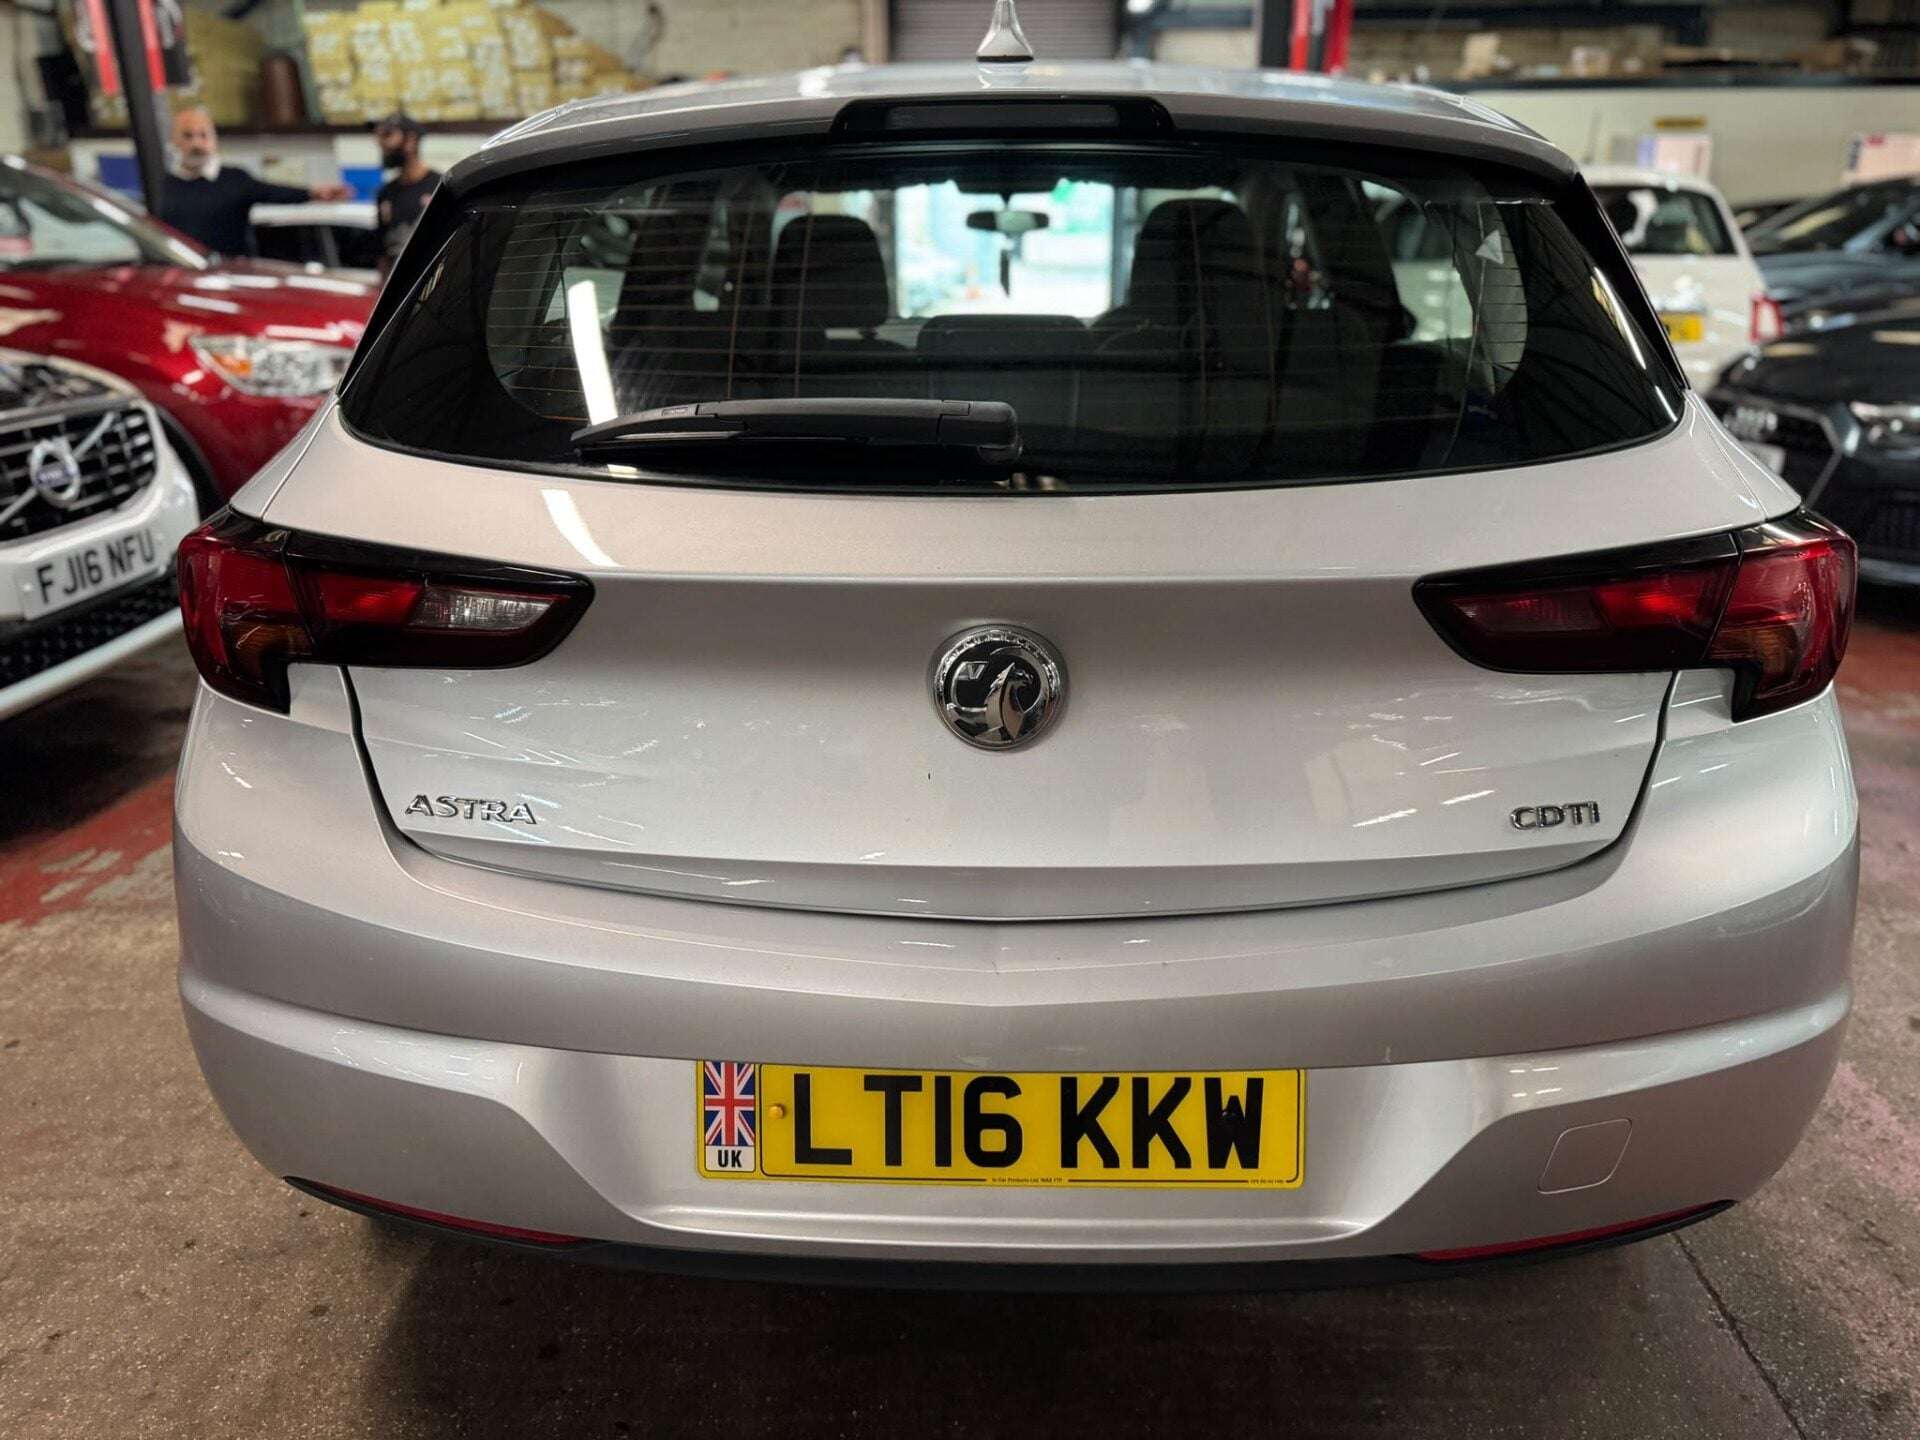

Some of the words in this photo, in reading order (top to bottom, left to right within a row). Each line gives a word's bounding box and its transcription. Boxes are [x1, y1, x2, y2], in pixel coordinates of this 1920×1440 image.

[37, 549, 103, 604] FJ16
[106, 528, 156, 578] NFU
[405, 794, 537, 824] ASTRA
[1510, 801, 1600, 830] CDTI
[793, 1072, 1024, 1168] LT16
[1059, 1076, 1264, 1170] KKW
[717, 1149, 743, 1168] UK
